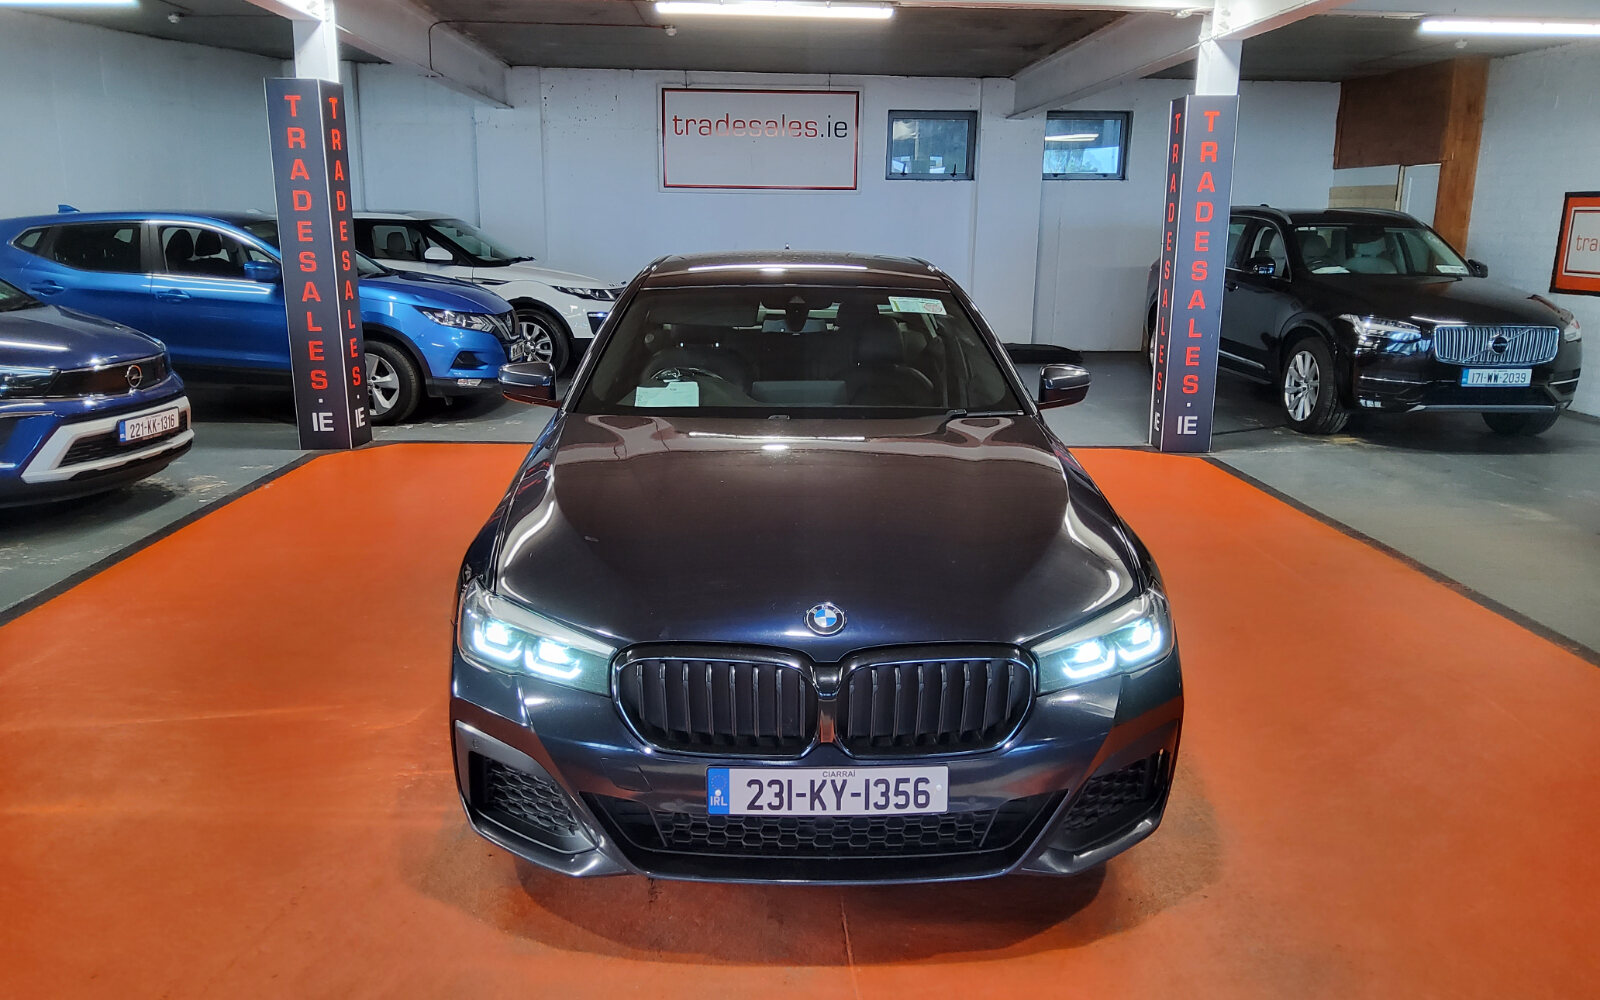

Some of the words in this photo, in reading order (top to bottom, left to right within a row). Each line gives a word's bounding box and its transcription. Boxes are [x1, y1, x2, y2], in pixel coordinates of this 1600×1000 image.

[672, 112, 848, 138] tradesales.ie
[1575, 234, 1600, 252] tra
[284, 95, 335, 432] TRADESALES.IE
[1176, 110, 1221, 435] TRADESALES.IE
[1471, 372, 1527, 383] 171-WW-2039
[129, 413, 175, 438] 221-KK-1316
[710, 796, 728, 806] IRL
[746, 777, 931, 811] 231-KY-1356
